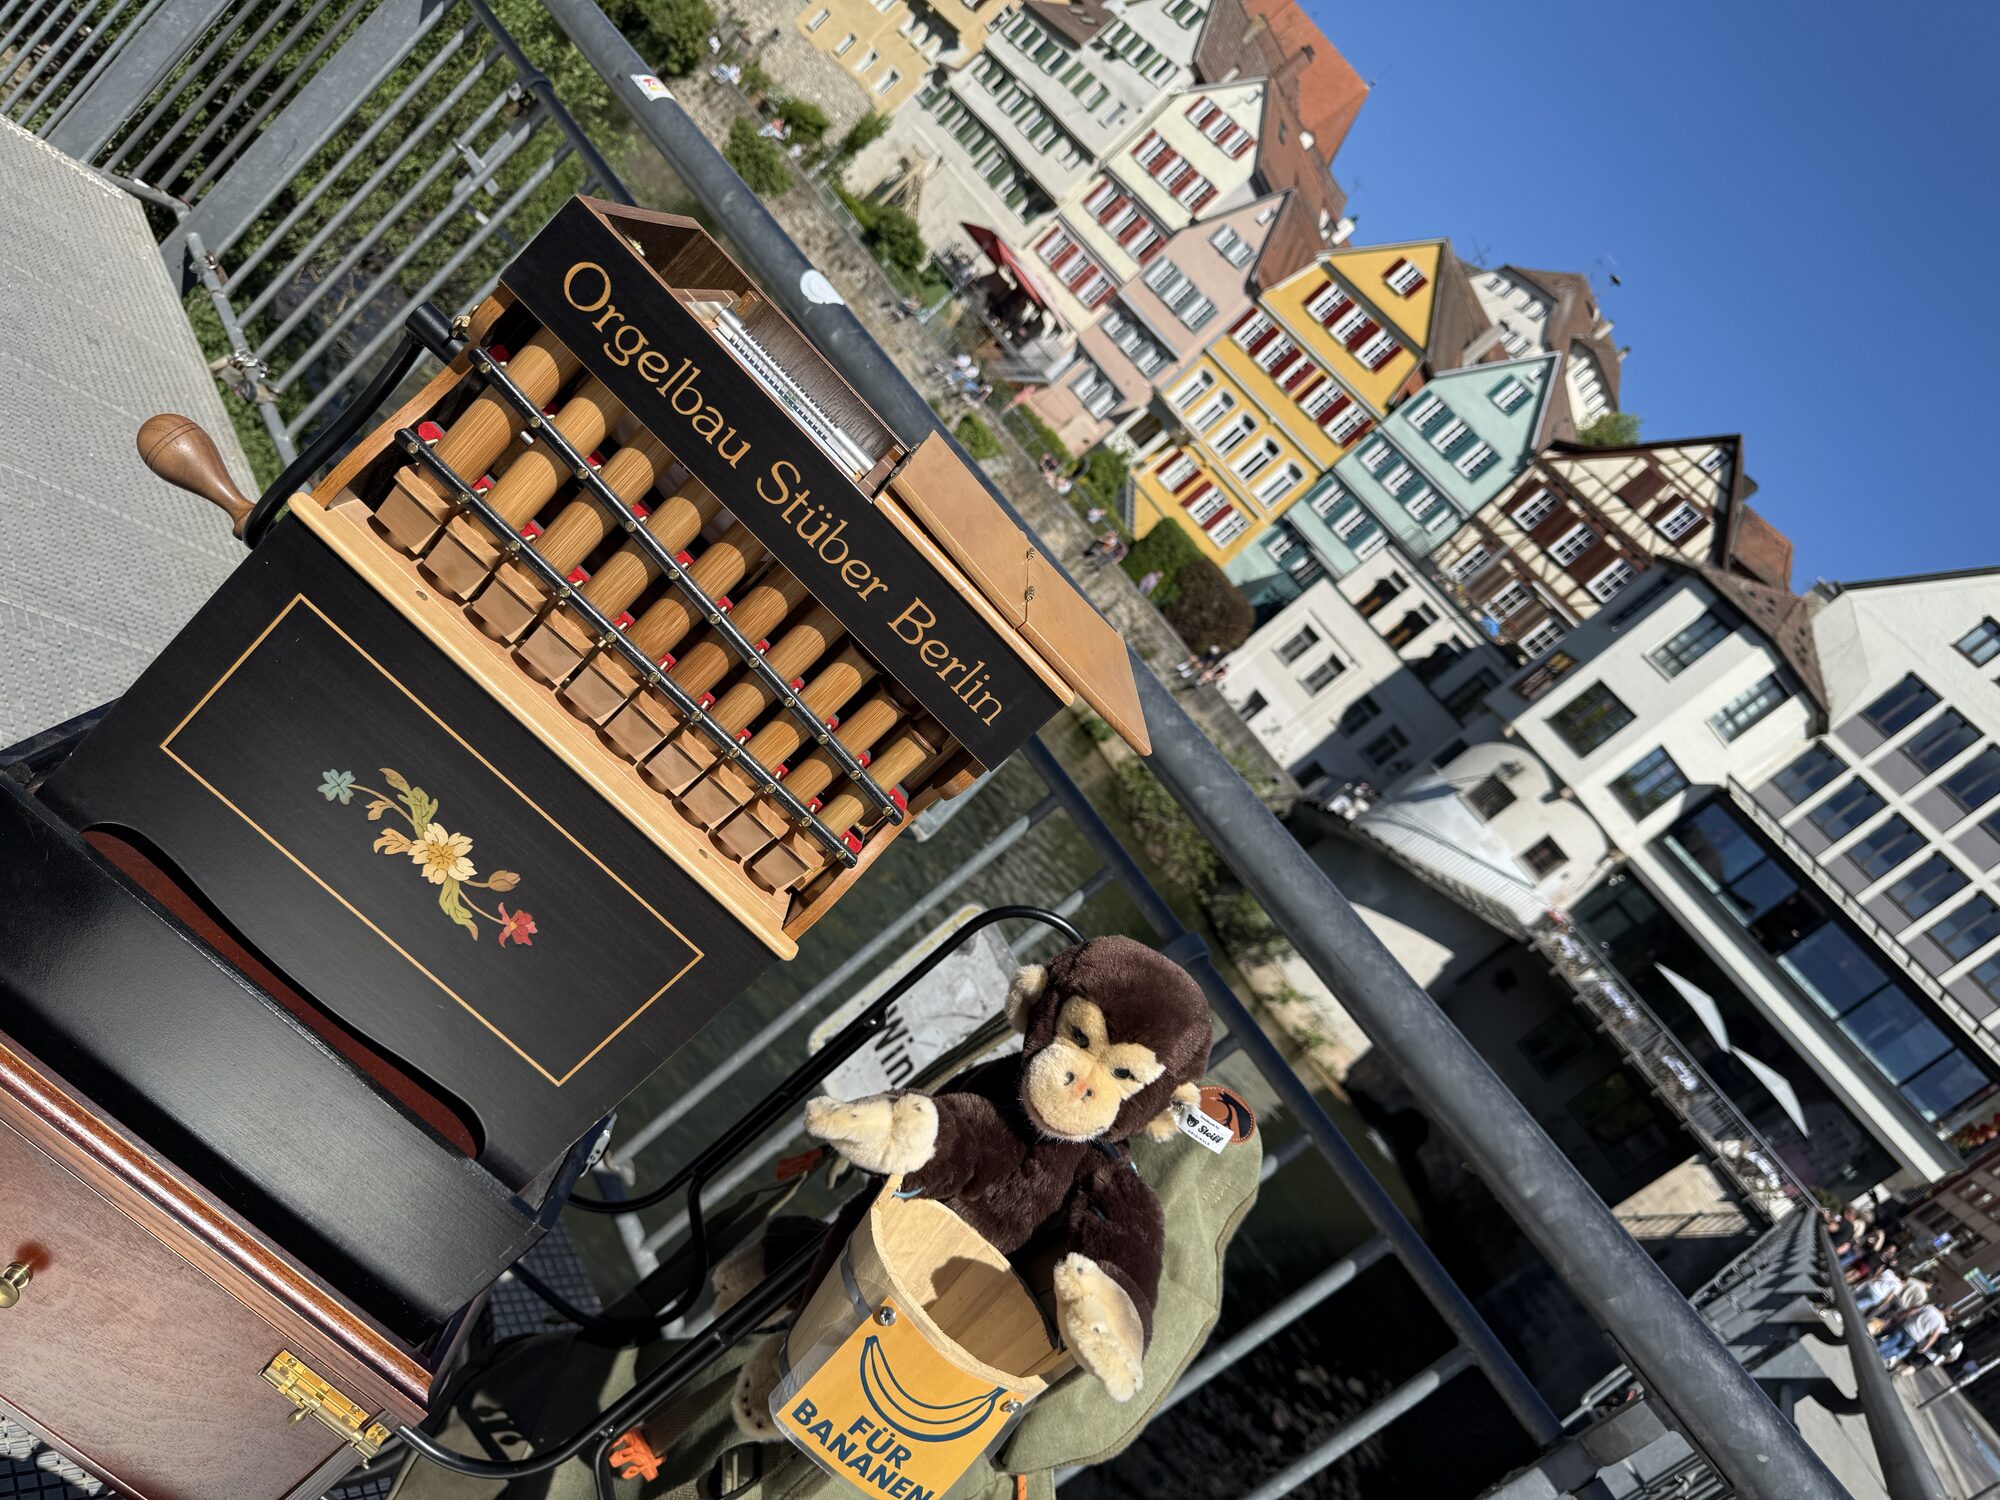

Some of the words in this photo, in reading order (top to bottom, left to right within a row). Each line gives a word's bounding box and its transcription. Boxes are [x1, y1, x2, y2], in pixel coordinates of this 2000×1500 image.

[564, 262, 751, 469] Orgelbau
[757, 461, 888, 601] Stüber
[888, 597, 1004, 726] Berlin
[1198, 1125, 1224, 1143] Steiff
[791, 1398, 935, 1500] BANANEN
[847, 1414, 912, 1470] FÜR
